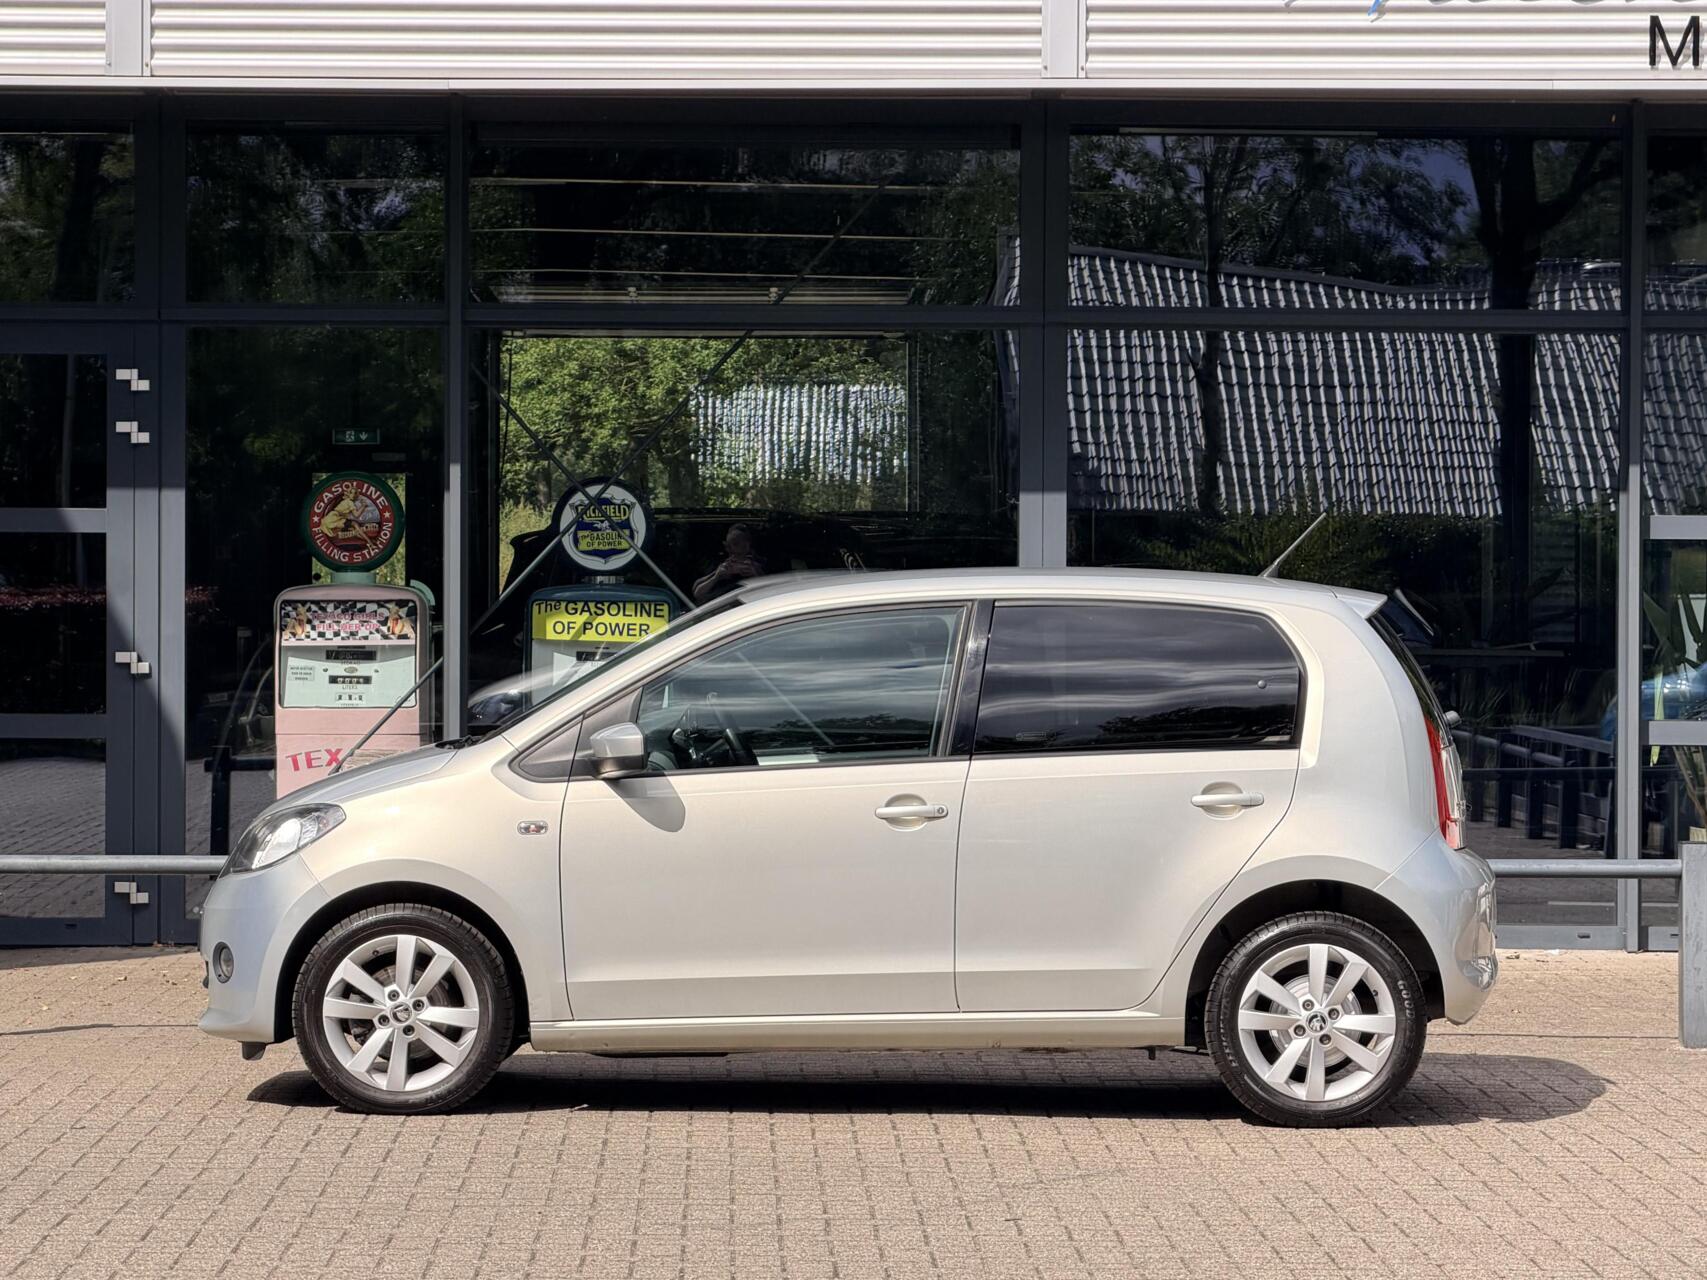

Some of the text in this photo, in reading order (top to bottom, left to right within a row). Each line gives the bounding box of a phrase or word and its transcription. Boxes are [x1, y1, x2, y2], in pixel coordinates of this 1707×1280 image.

[314, 481, 388, 513] GASOLINE
[312, 522, 393, 562] FILLING STATION
[590, 532, 623, 541] GASOLIN
[535, 600, 665, 618] The GASOLINE
[552, 621, 651, 637] OF POWER
[285, 748, 343, 772] TEX
